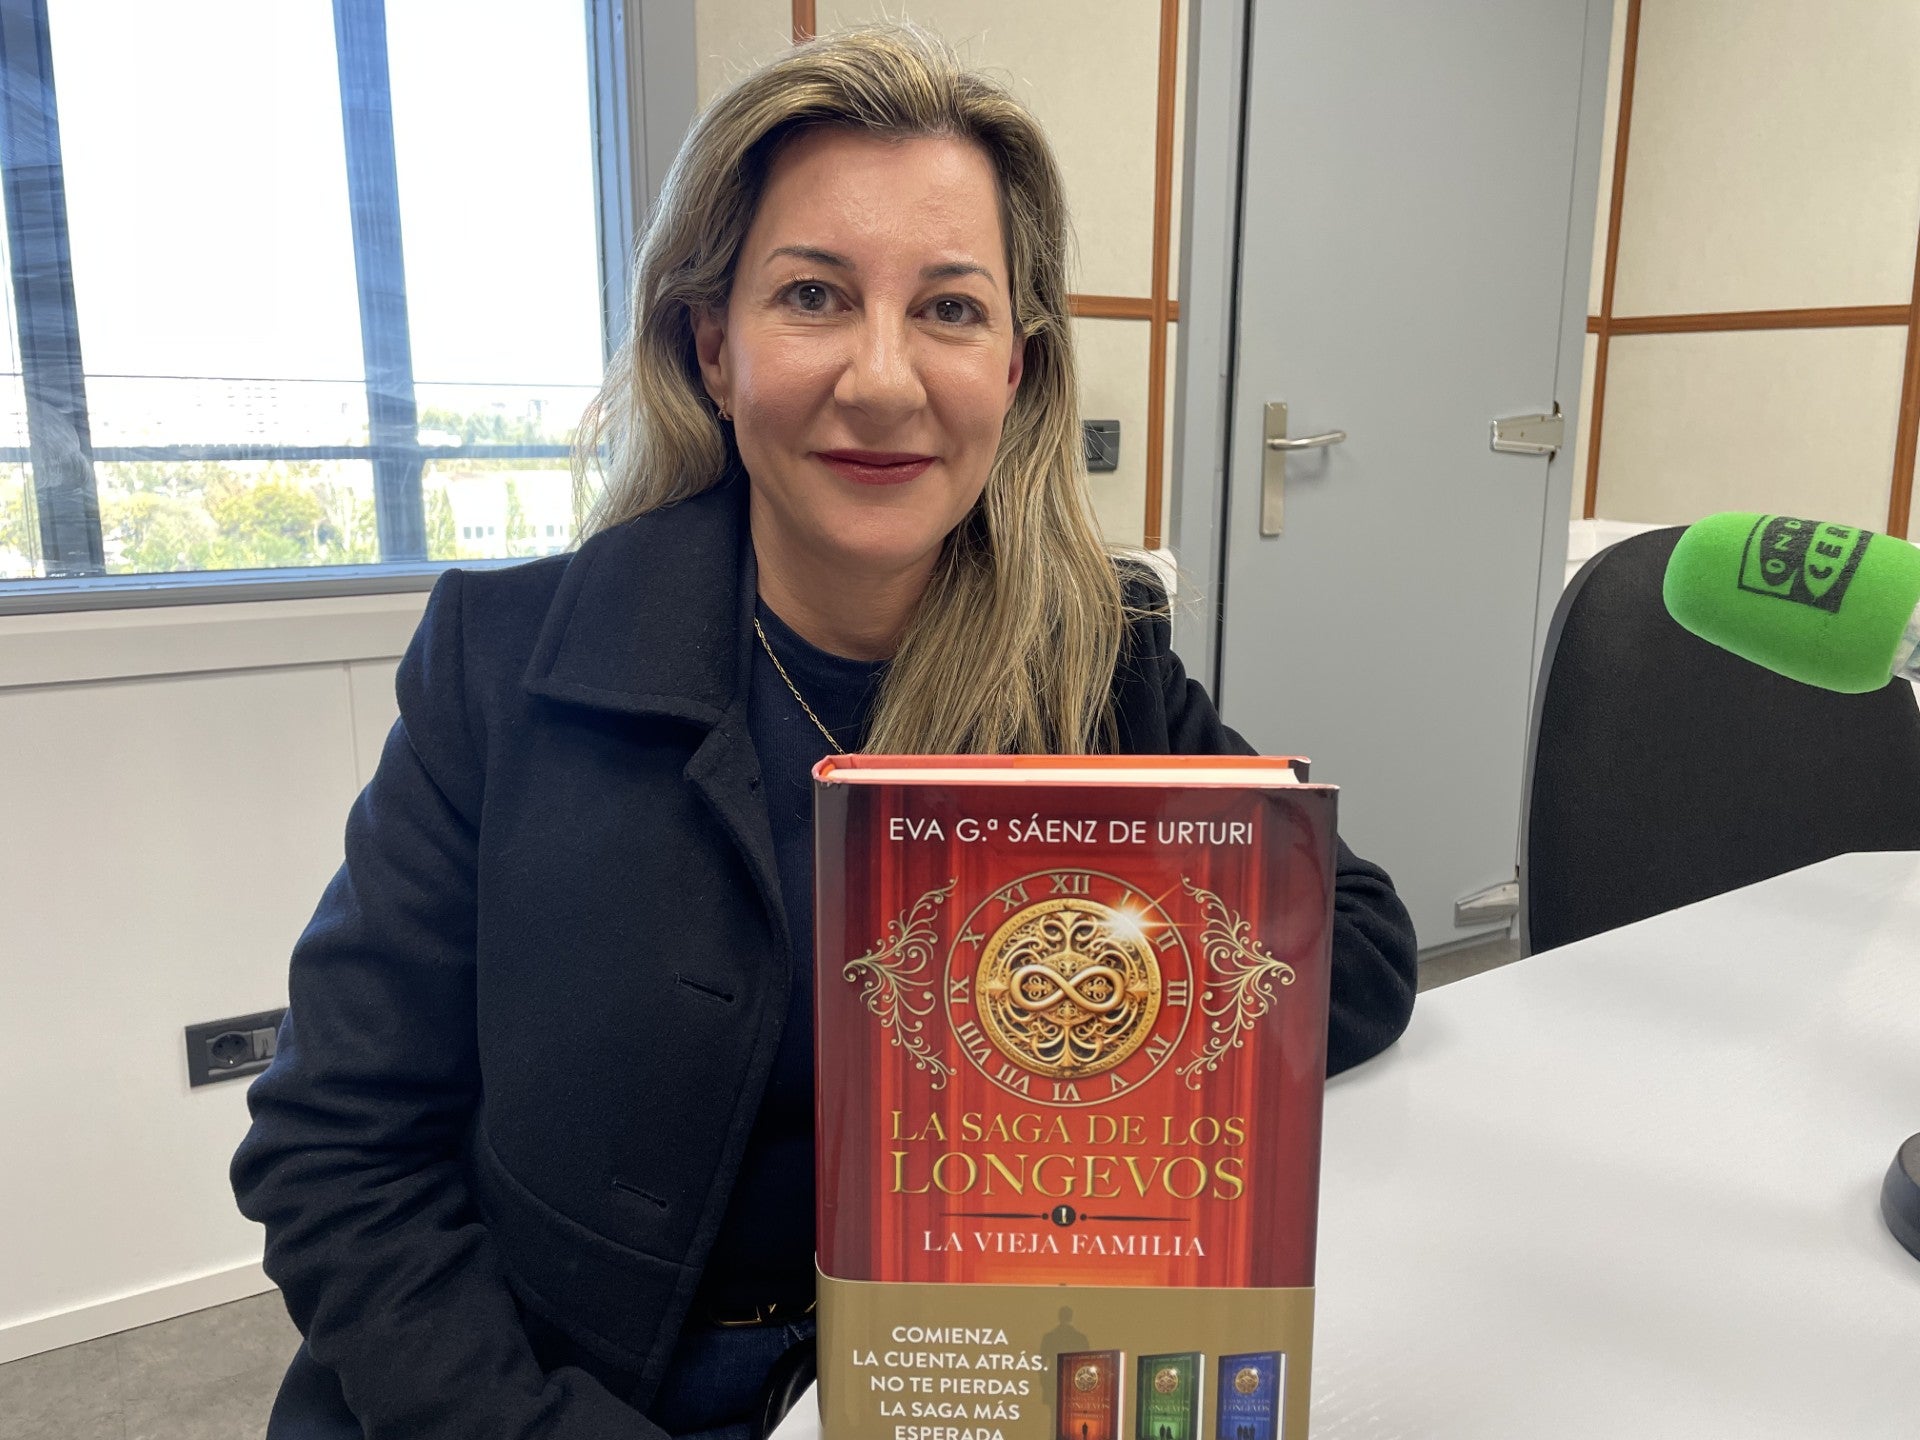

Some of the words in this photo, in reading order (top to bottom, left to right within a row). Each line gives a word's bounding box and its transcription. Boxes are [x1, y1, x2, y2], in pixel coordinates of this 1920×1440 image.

[1765, 520, 1802, 575] OND
[889, 817, 945, 841] EVA
[1007, 813, 1097, 843] SÁENZ
[1109, 820, 1147, 844] DE
[1158, 821, 1253, 845] URTURI
[995, 883, 1030, 913] XI
[1049, 875, 1091, 895] XII
[960, 926, 986, 950] X
[1154, 929, 1179, 953] II
[950, 976, 970, 1004] IX
[1166, 979, 1188, 1007] III
[957, 1020, 992, 1067] VIII
[1144, 1033, 1173, 1065] IV
[995, 1064, 1031, 1095] VII
[1052, 1083, 1082, 1102] VI
[1108, 1073, 1129, 1093] V
[890, 1110, 947, 1141] LA
[961, 1112, 1073, 1144] SAGA
[1087, 1114, 1148, 1146] DE
[1161, 1116, 1246, 1147] LOS
[889, 1150, 1245, 1201] LONGEVOS
[923, 1230, 964, 1252] LA
[973, 1231, 1060, 1254] VIEJA
[1071, 1233, 1206, 1257] FAMILIA
[891, 1326, 1009, 1346] COMIENZA
[852, 1350, 879, 1367] LA
[884, 1351, 970, 1369] CUENTA
[975, 1350, 1049, 1372] ATRÁS.
[870, 1375, 905, 1392] NO
[909, 1377, 933, 1393] TE
[940, 1377, 1030, 1396] PIERDAS
[880, 1401, 906, 1417] LA
[911, 1402, 968, 1419] SAGA
[973, 1400, 1020, 1421] MÁS
[894, 1425, 1005, 1440] ESPERADA
